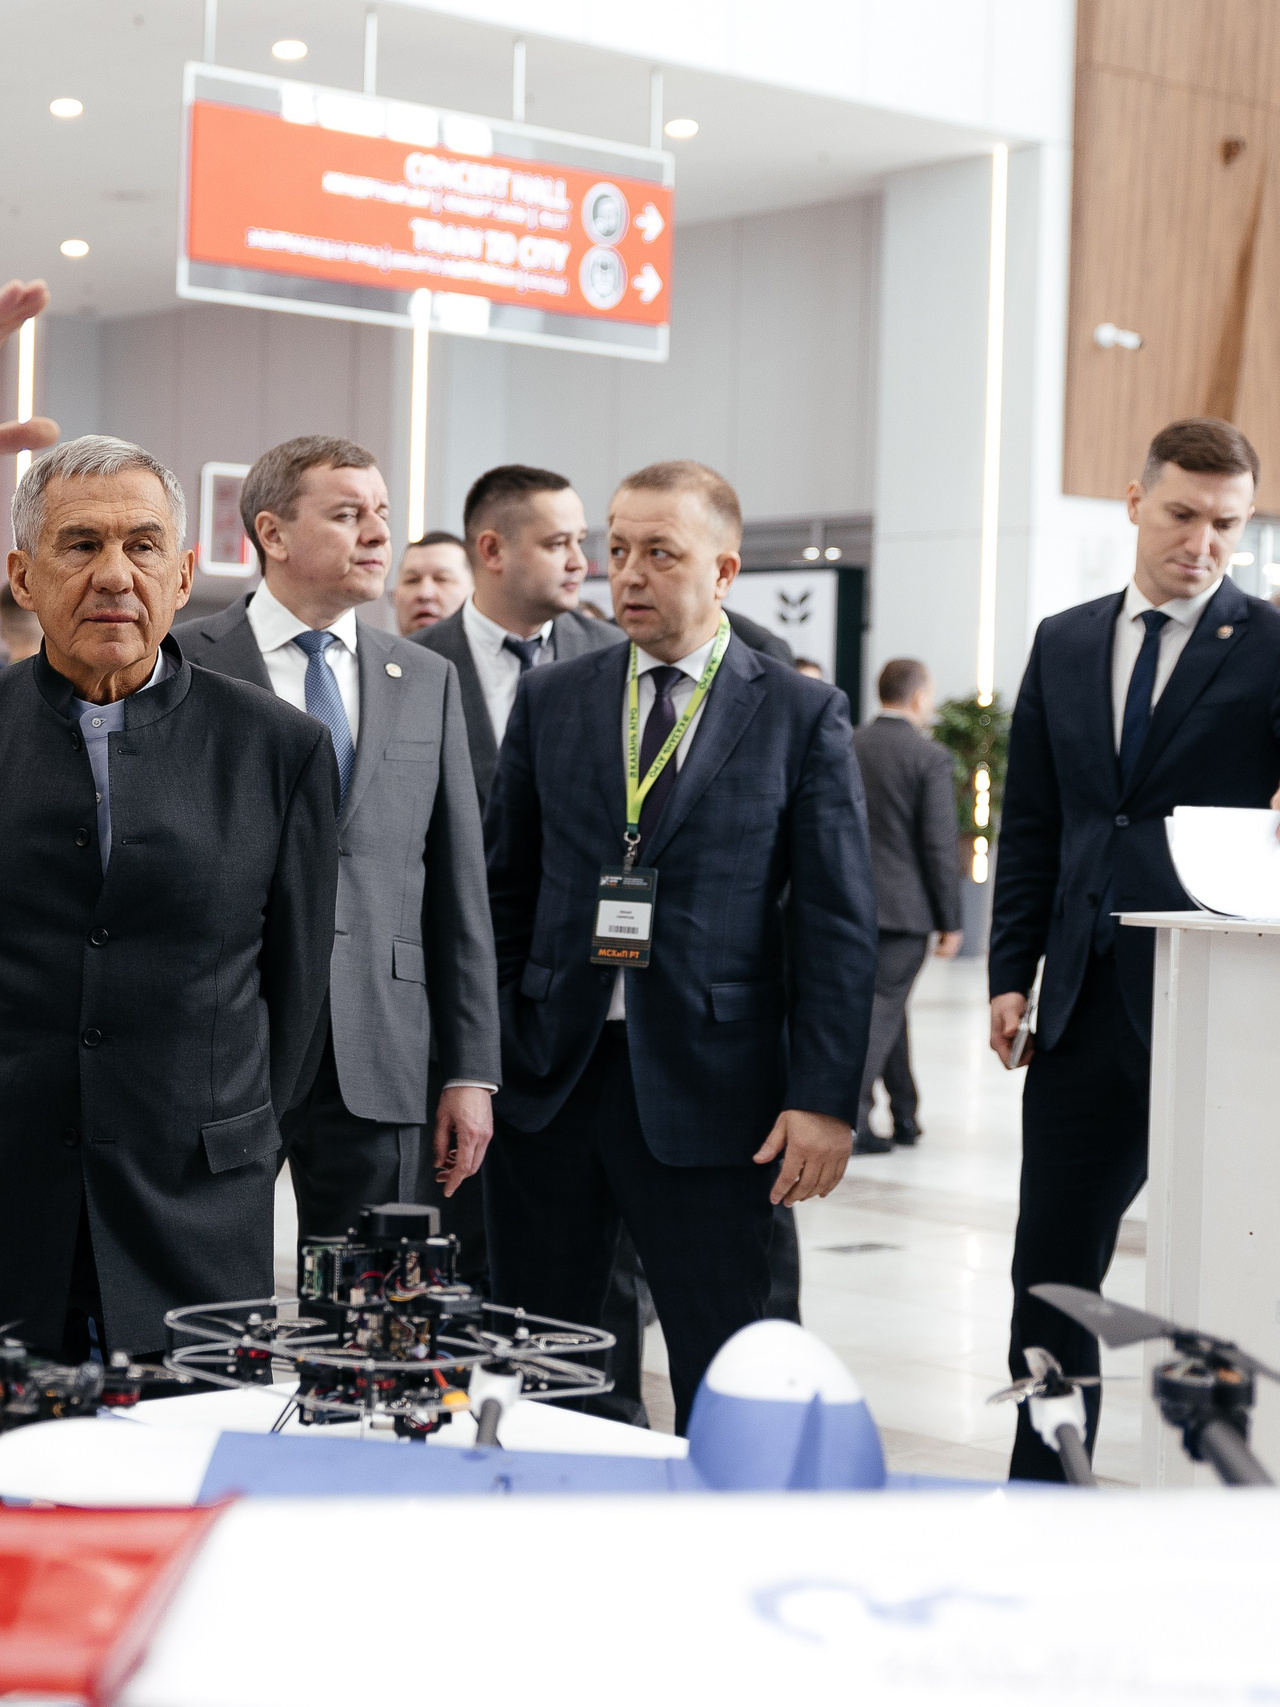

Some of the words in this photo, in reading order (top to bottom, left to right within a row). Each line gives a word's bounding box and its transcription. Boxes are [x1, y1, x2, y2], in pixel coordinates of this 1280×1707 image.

[409, 217, 483, 259] TRAIN
[483, 229, 518, 265] TO
[518, 235, 571, 272] CITY
[629, 707, 638, 731] АГРО
[628, 733, 638, 770] КАЗАНЬ
[629, 950, 640, 959] РТ
